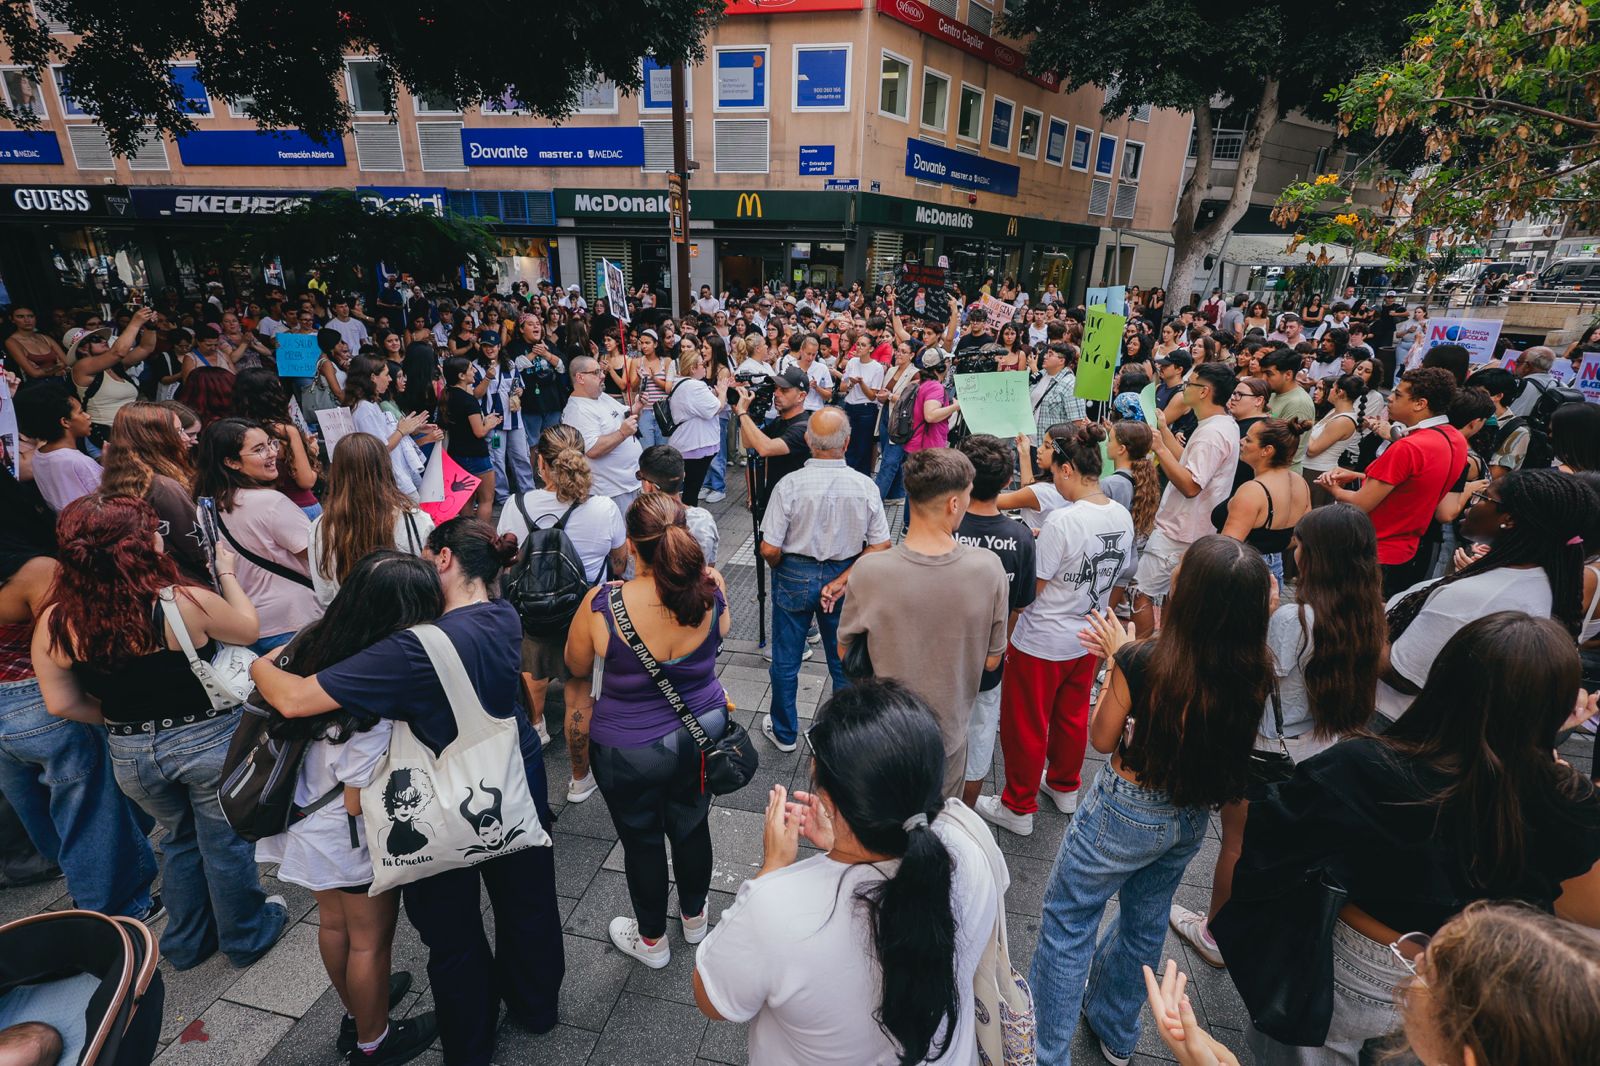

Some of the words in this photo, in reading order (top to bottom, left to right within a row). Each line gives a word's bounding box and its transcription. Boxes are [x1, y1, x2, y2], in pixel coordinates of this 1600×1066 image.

[938, 18, 961, 40] Centro
[961, 30, 985, 50] Capilar
[278, 151, 311, 160] Formación
[311, 151, 335, 159] Abierta
[469, 143, 529, 159] Davante
[594, 150, 623, 159] MEDAC
[913, 153, 947, 176] Davante
[14, 189, 90, 211] GUESS
[916, 205, 974, 229] McDonald's
[984, 534, 1018, 551] York
[612, 600, 635, 640] BIMBA
[632, 643, 661, 678] BIMBA
[657, 678, 684, 713] BIMBA
[681, 713, 708, 746] BIMBA
[381, 857, 394, 867] Tú
